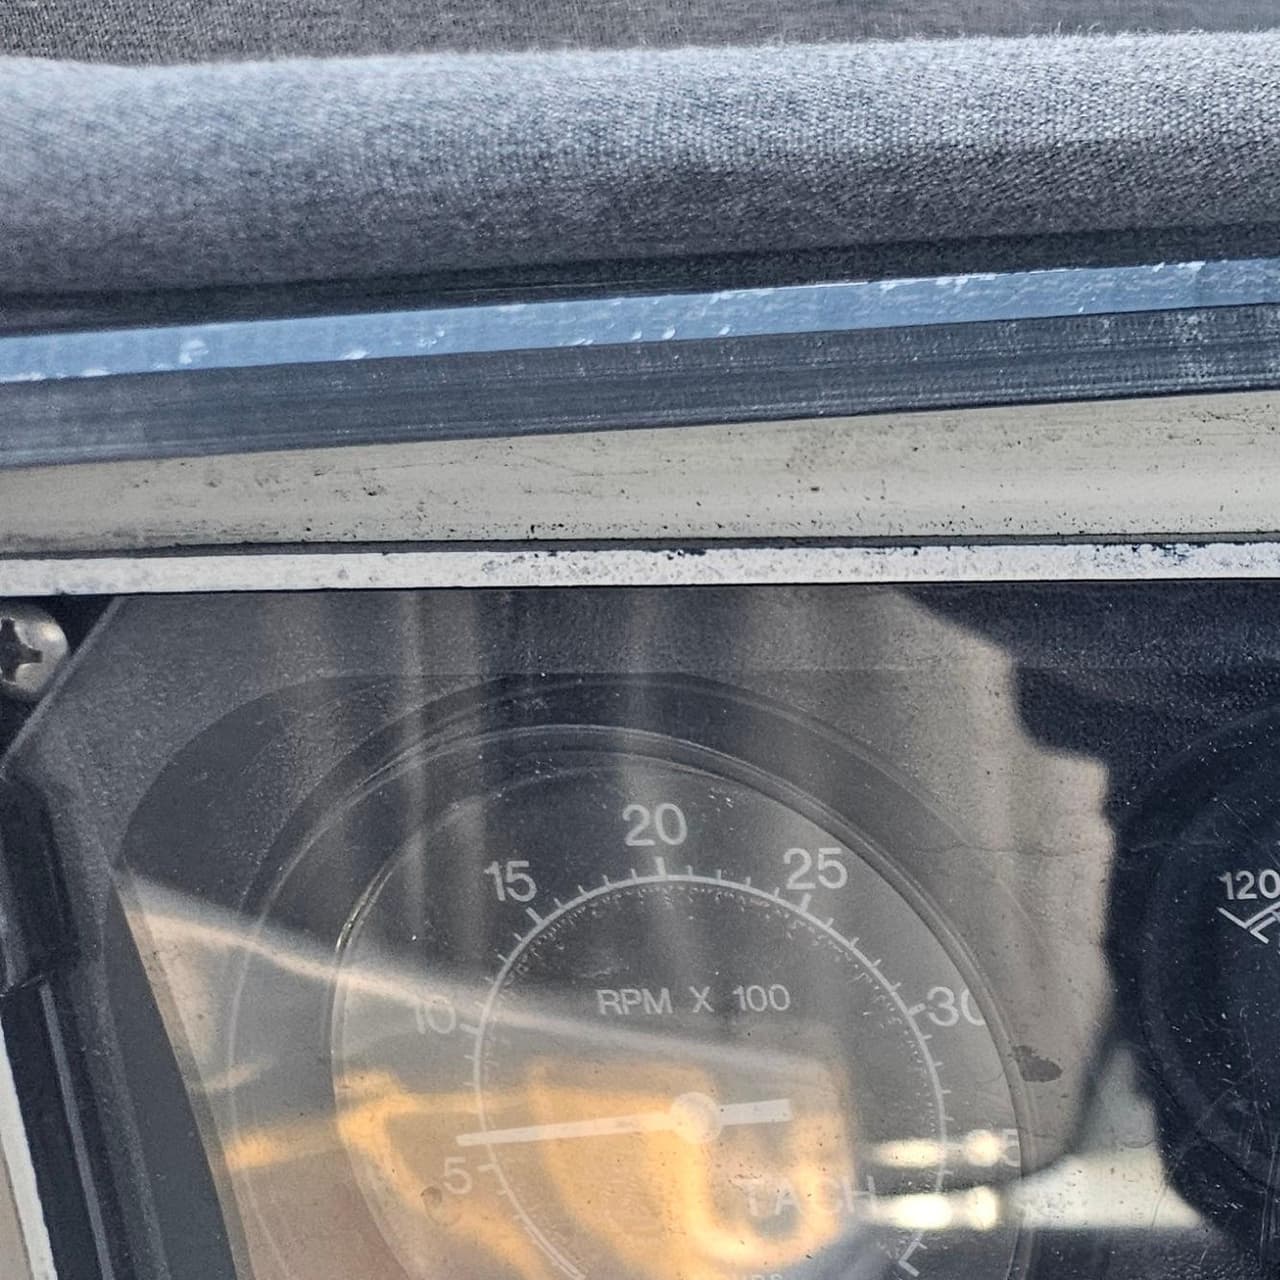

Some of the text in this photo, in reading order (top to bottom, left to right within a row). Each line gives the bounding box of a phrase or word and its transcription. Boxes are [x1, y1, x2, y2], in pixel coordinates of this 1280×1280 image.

[622, 803, 688, 847] 20
[485, 860, 537, 902] 15
[783, 848, 848, 890] 25
[412, 995, 457, 1036] 10
[598, 985, 790, 1016] RPM X 100
[443, 1158, 472, 1195] 5
